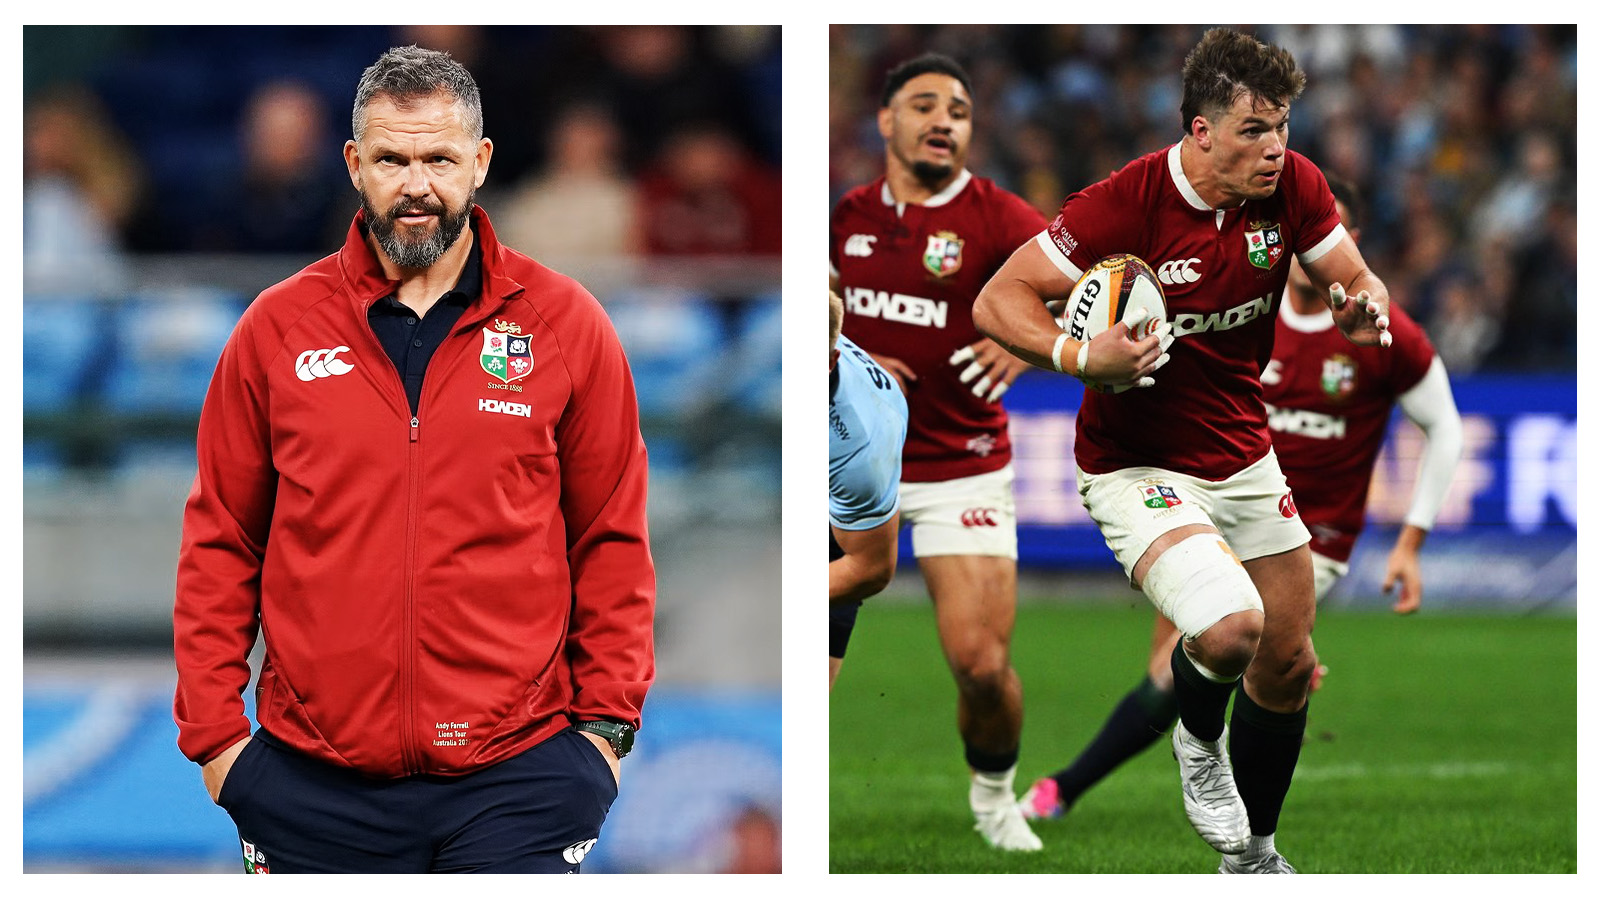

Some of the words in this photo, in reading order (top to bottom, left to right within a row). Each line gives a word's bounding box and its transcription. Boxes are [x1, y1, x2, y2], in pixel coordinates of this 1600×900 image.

[1053, 235, 1071, 256] LIONS
[1061, 227, 1078, 247] QATAR
[844, 286, 948, 328] HOWDEN
[487, 382, 508, 390] SINCE
[478, 398, 531, 418] HOWDEN
[436, 722, 449, 730] Andy
